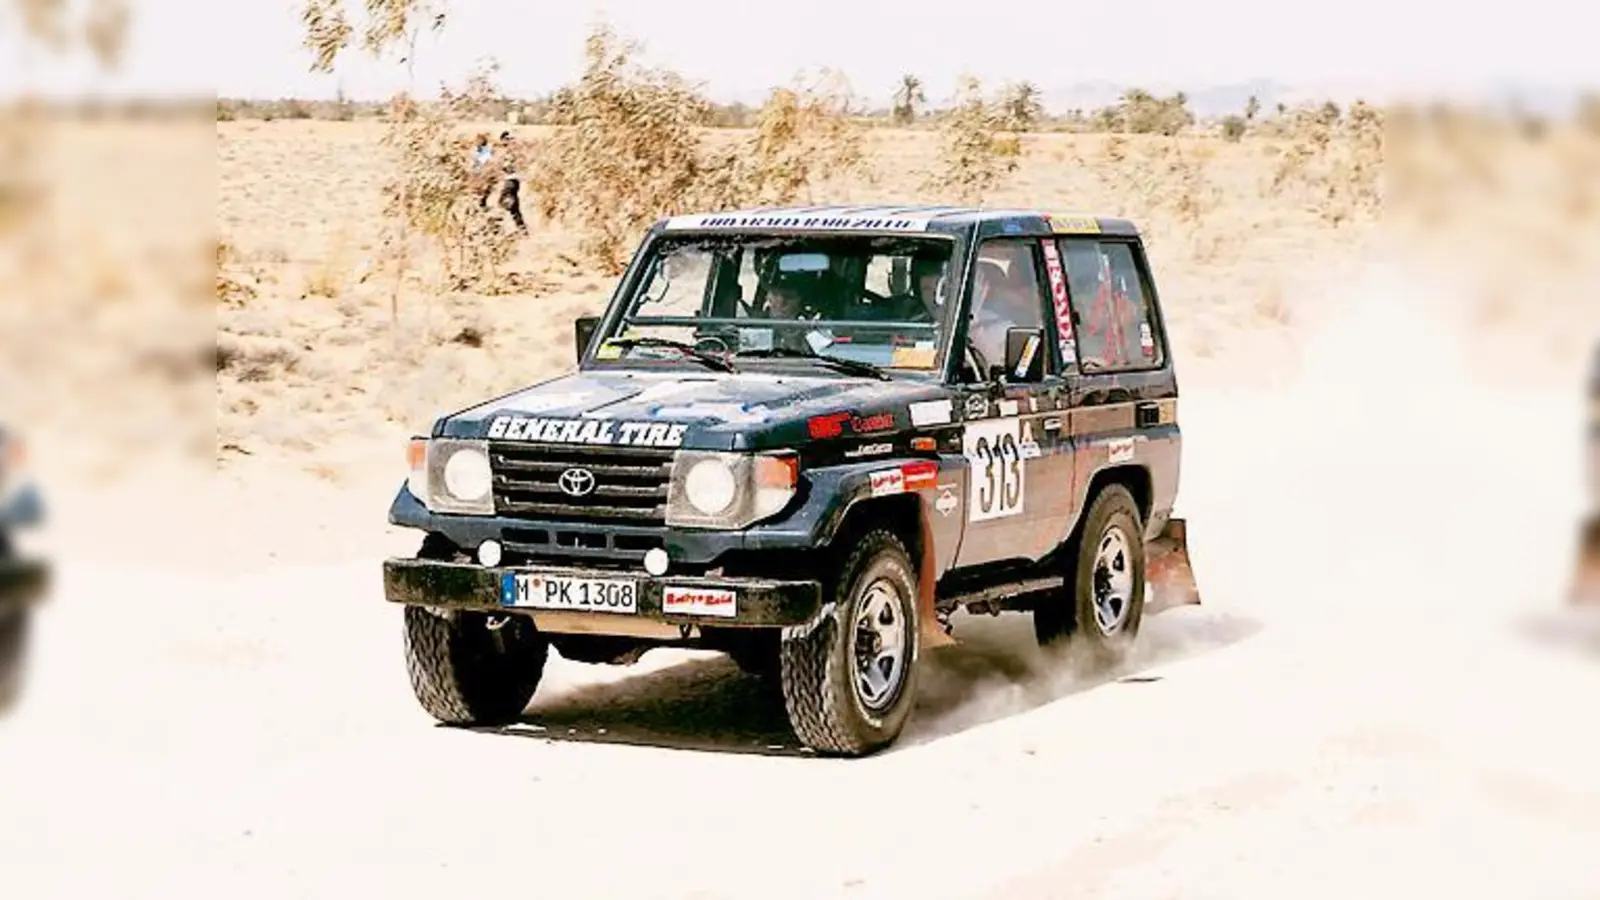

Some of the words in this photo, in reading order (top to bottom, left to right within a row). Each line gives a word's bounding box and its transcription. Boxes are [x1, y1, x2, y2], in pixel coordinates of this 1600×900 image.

[487, 415, 615, 444] GENERAL
[618, 421, 689, 447] TIRE
[975, 432, 1020, 514] 313
[514, 578, 529, 601] M
[545, 580, 573, 605] PK
[578, 581, 634, 608] 1308
